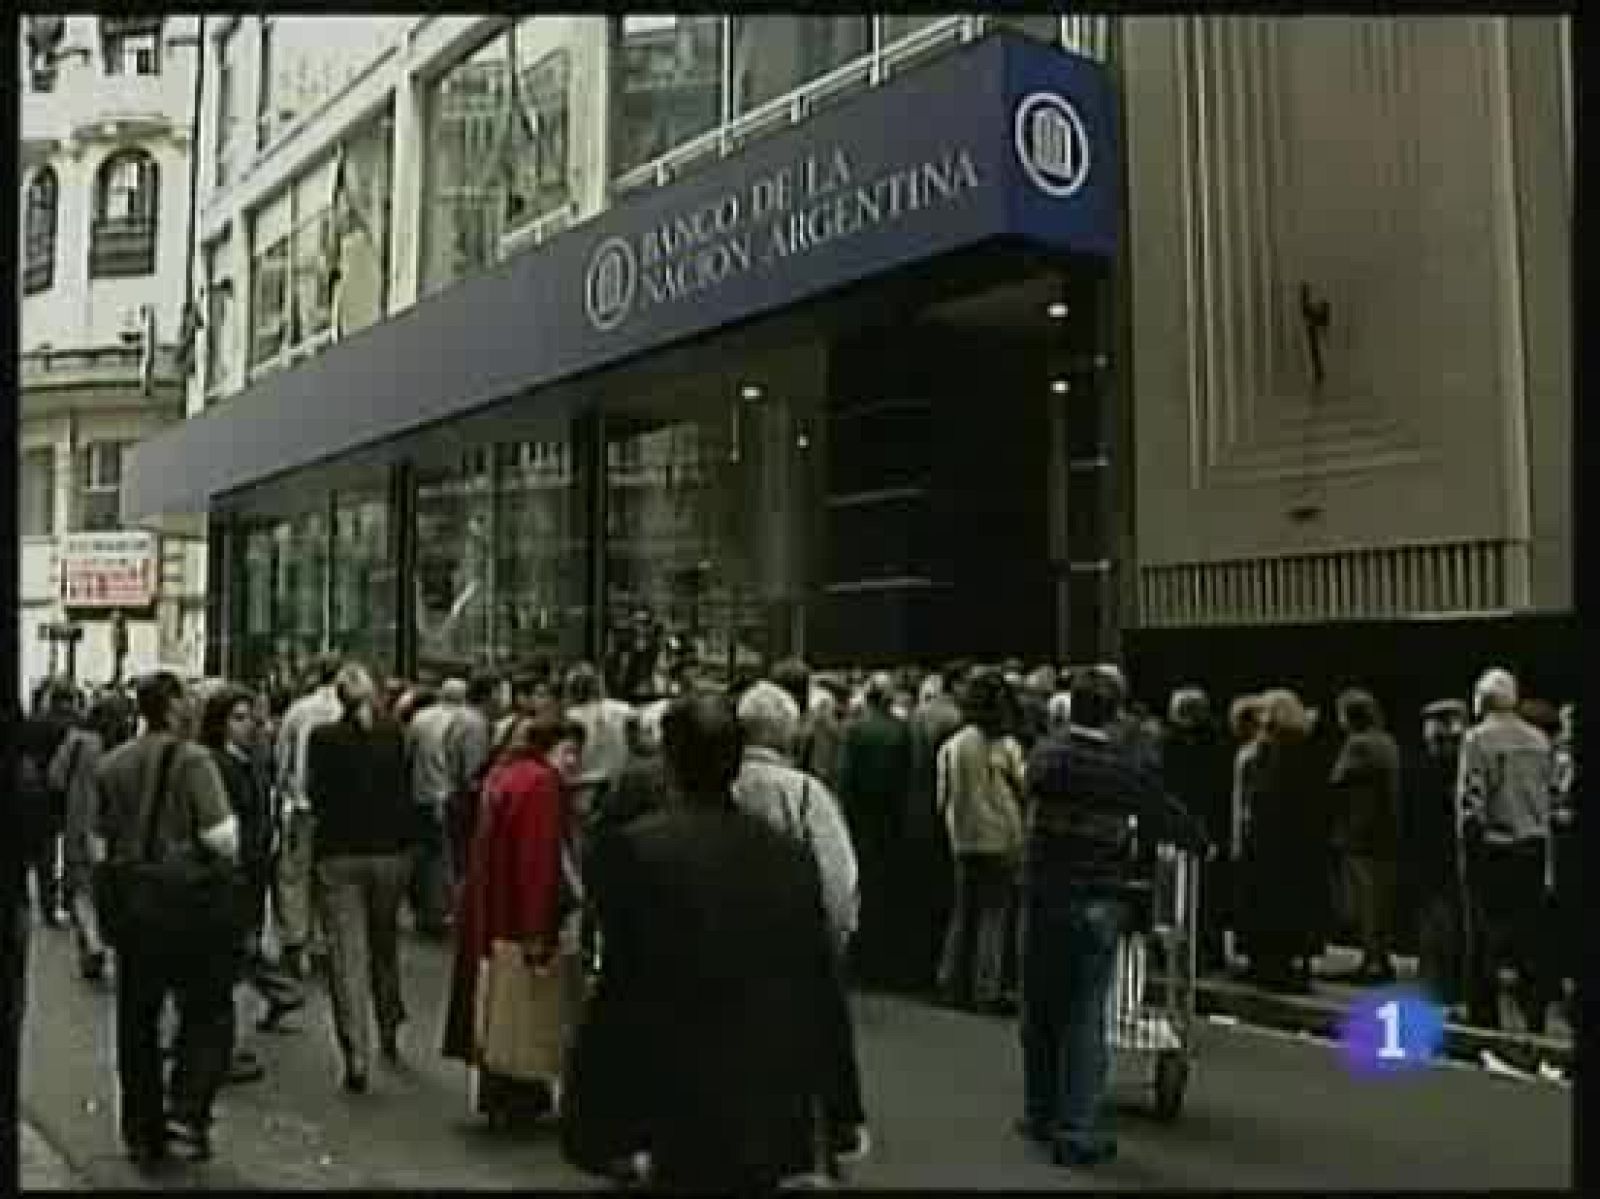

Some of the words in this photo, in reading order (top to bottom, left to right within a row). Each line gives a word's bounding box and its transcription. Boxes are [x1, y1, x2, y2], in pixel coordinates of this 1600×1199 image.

[642, 194, 740, 266] BANCO
[752, 167, 792, 217] DE
[801, 146, 851, 195] LA
[767, 148, 979, 258] ARGENTINA
